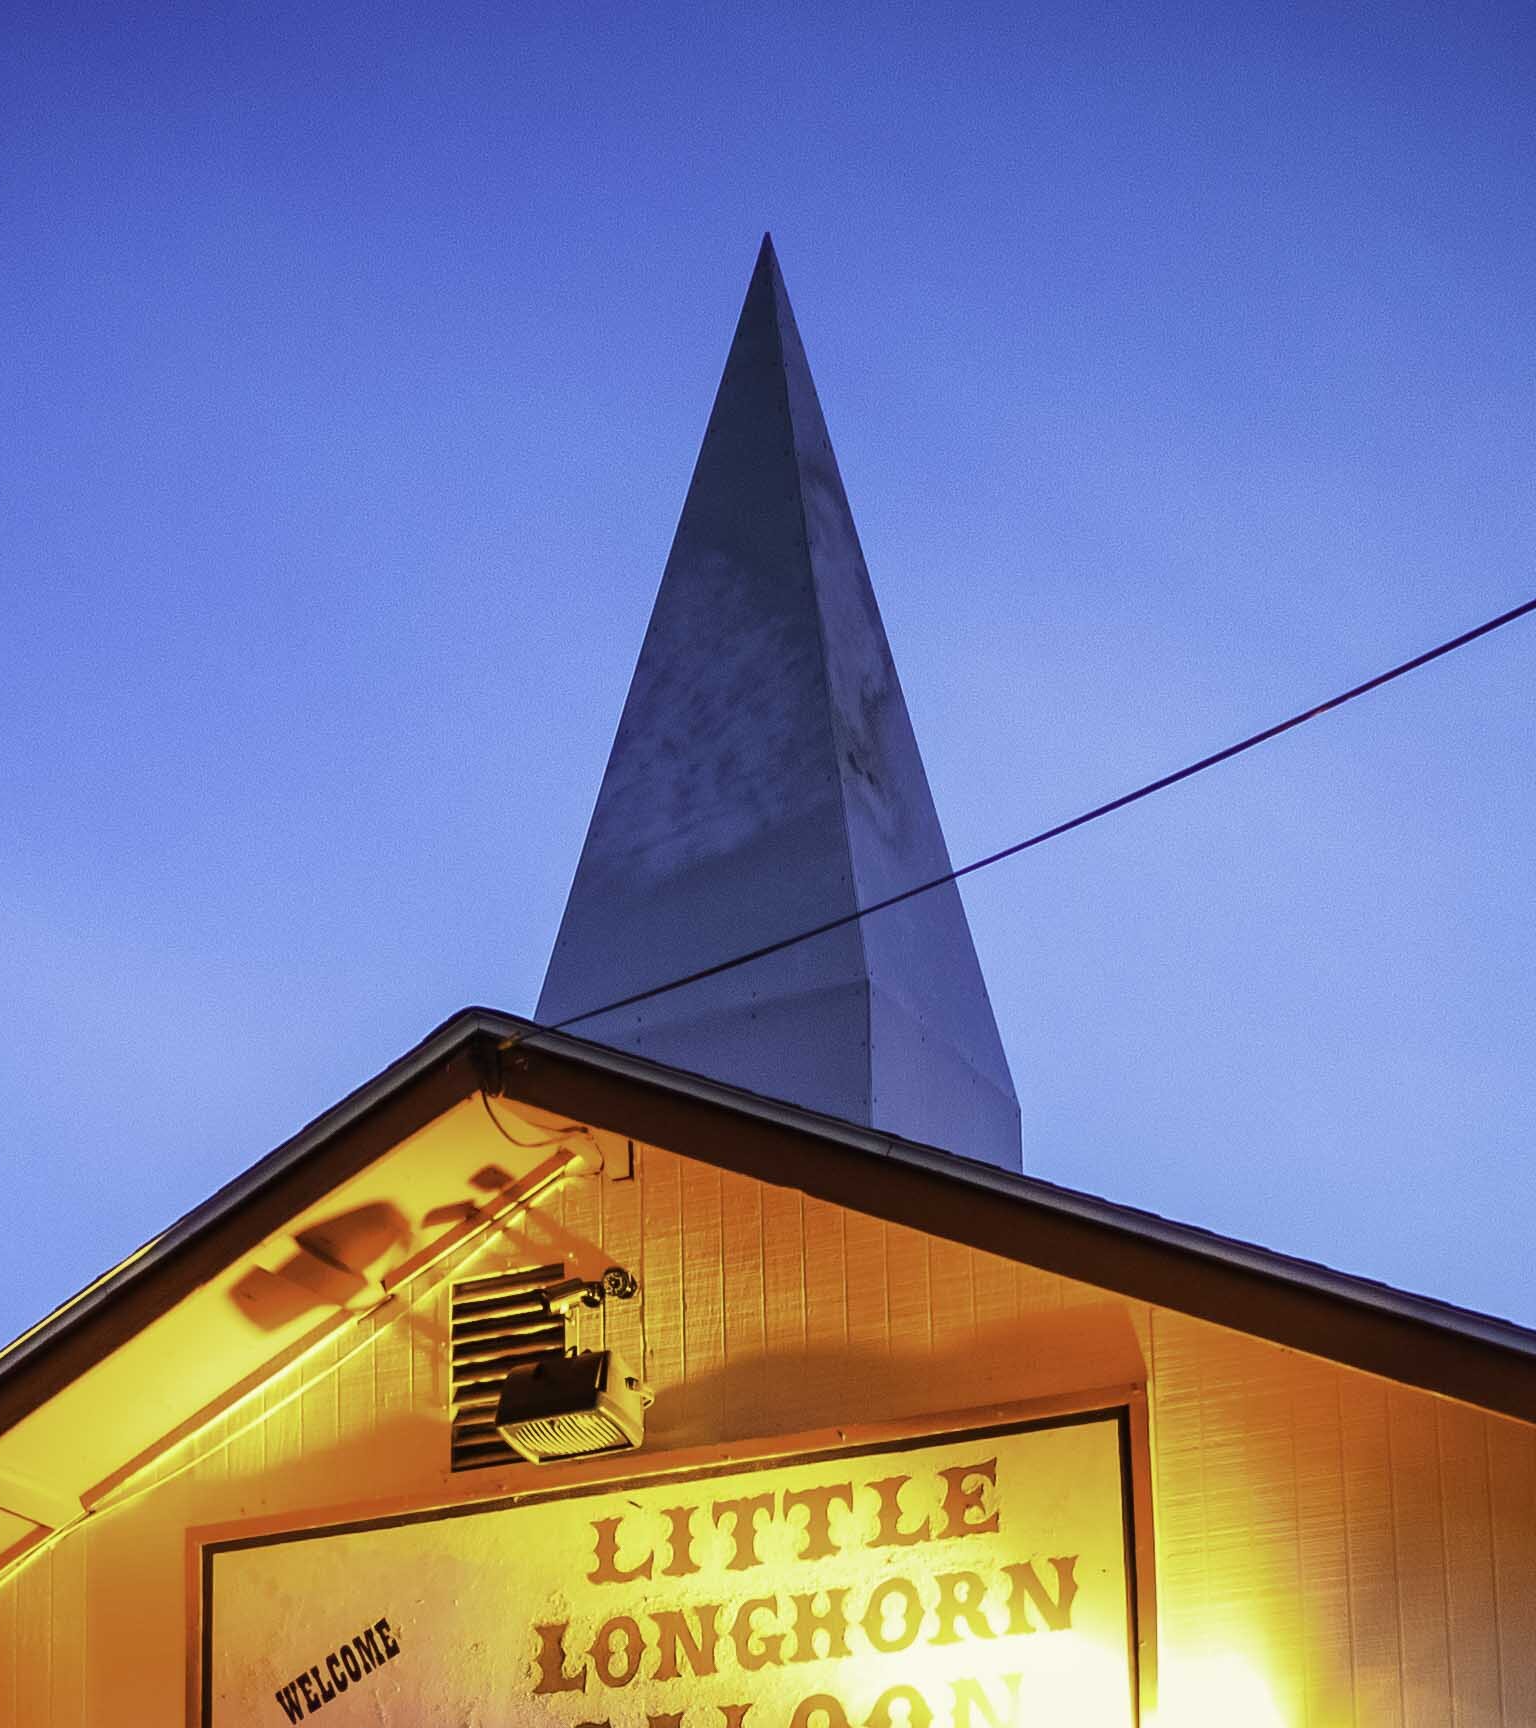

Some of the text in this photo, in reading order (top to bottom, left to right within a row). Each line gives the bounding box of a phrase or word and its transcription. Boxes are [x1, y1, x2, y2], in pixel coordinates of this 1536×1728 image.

[586, 1457, 1000, 1585] LITTLE
[275, 1617, 400, 1725] WELCOME
[532, 1555, 1080, 1695] LONGHORN
